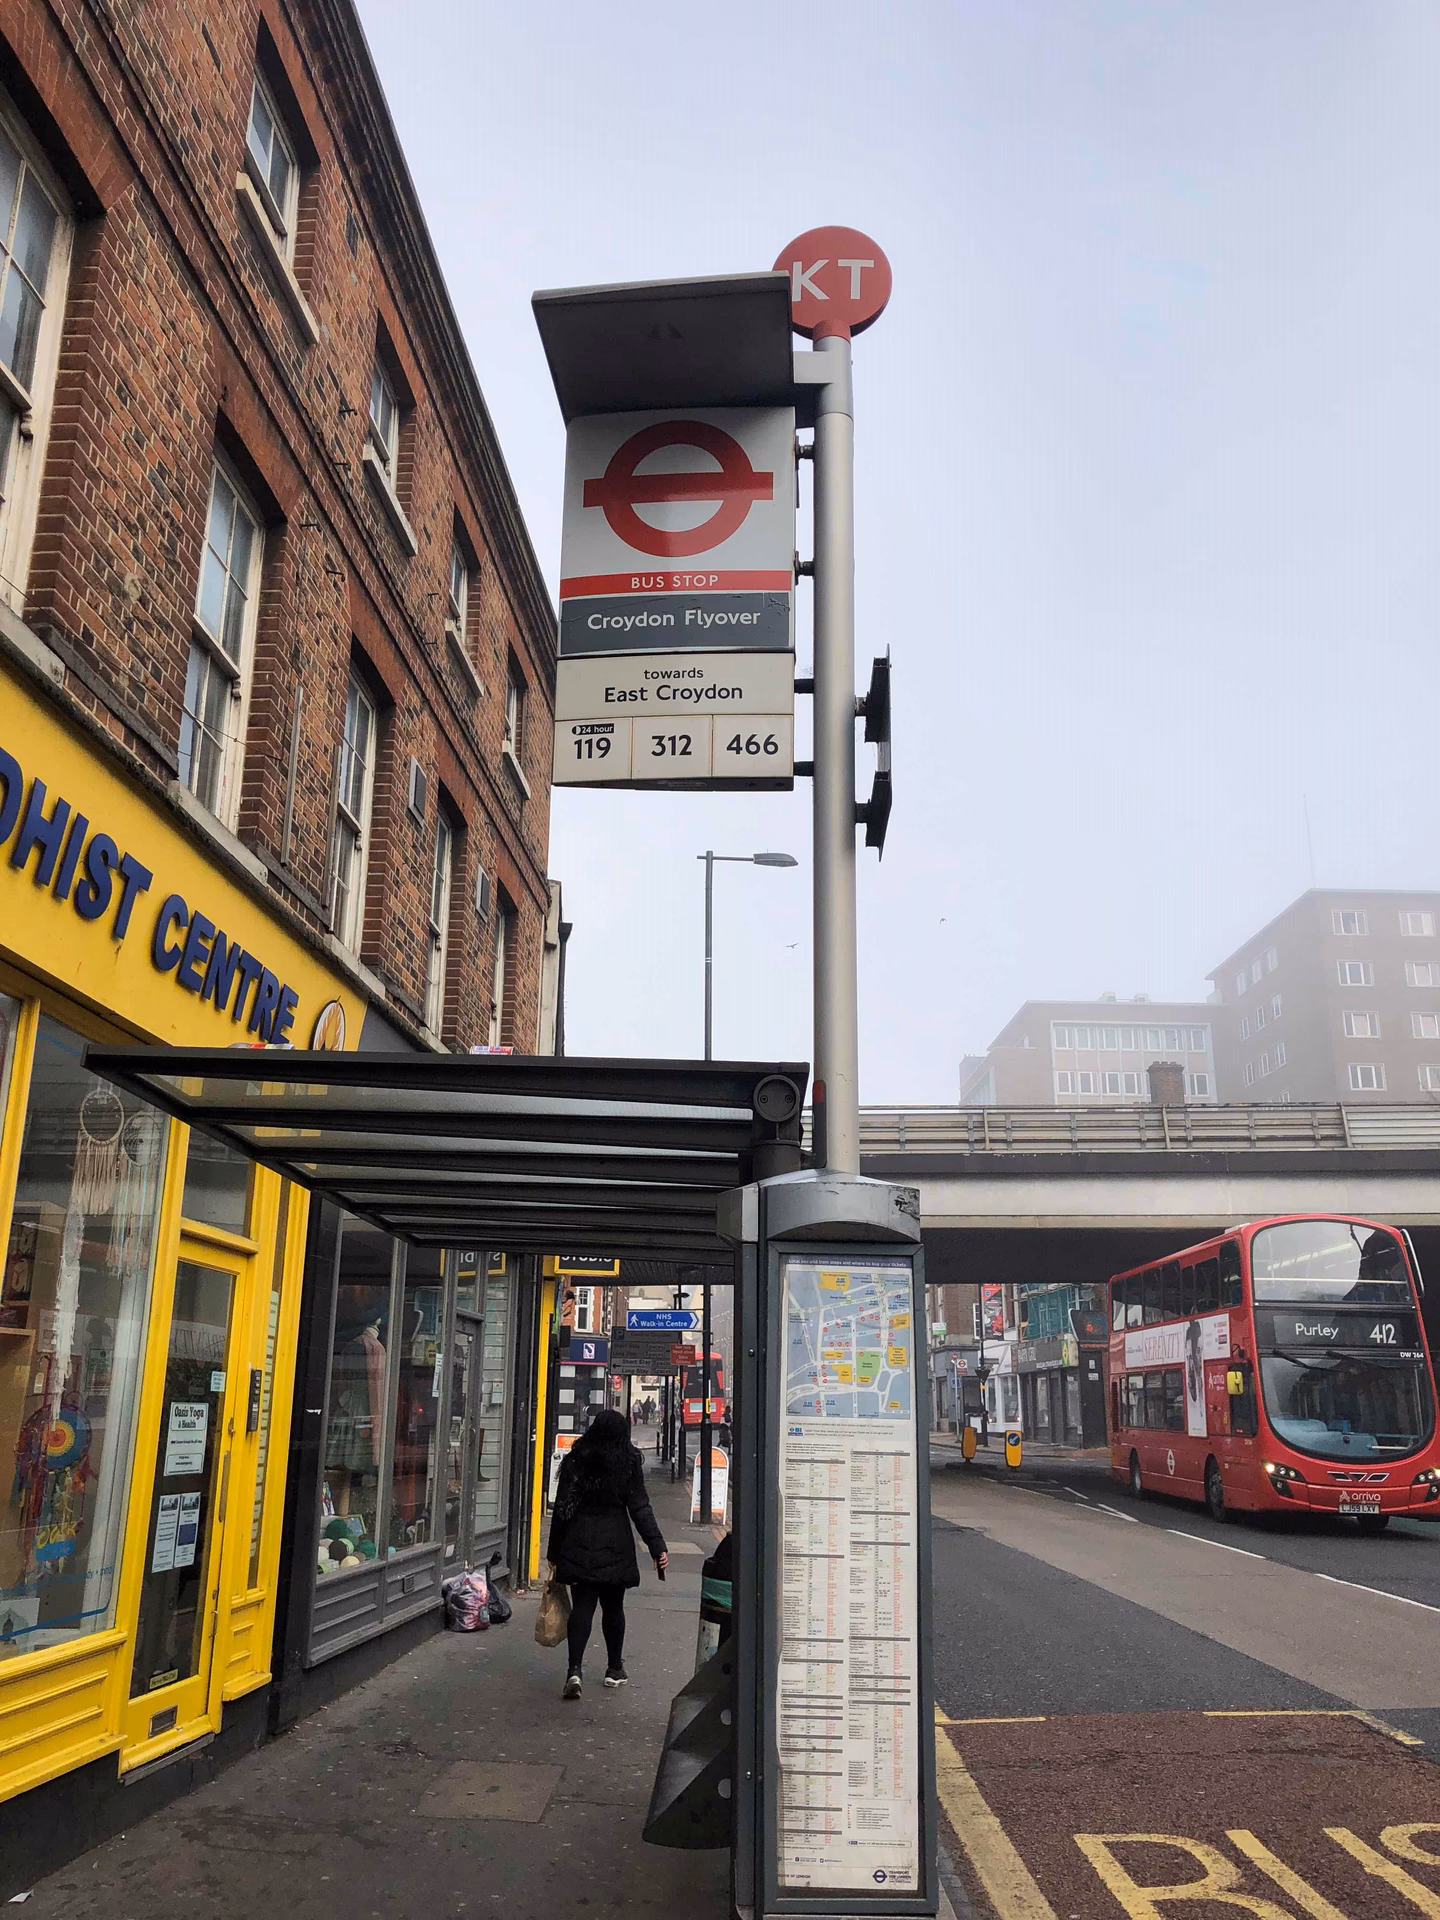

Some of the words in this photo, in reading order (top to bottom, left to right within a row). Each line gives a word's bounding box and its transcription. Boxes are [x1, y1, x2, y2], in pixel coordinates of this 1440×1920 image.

[792, 259, 875, 302] KT
[631, 575, 665, 589] BUS
[672, 574, 719, 588] STOP
[587, 611, 675, 631] Croydon
[684, 608, 761, 629] Flyover
[643, 667, 704, 680] towards
[604, 686, 648, 703] East
[656, 684, 743, 703] Croydon
[581, 725, 592, 734] 24
[593, 724, 613, 733] hour
[574, 737, 612, 760] 119
[651, 734, 692, 756] 312
[726, 733, 779, 755] 466
[154, 893, 300, 1044] CENTRE
[1295, 1322, 1339, 1340] Purley
[1369, 1323, 1397, 1345] 412
[1143, 1331, 1181, 1362] SERENITY
[174, 1406, 189, 1418] Oasis
[189, 1406, 204, 1420] Yoga
[1351, 1491, 1381, 1501] arriva
[1341, 1504, 1361, 1512] LJ59
